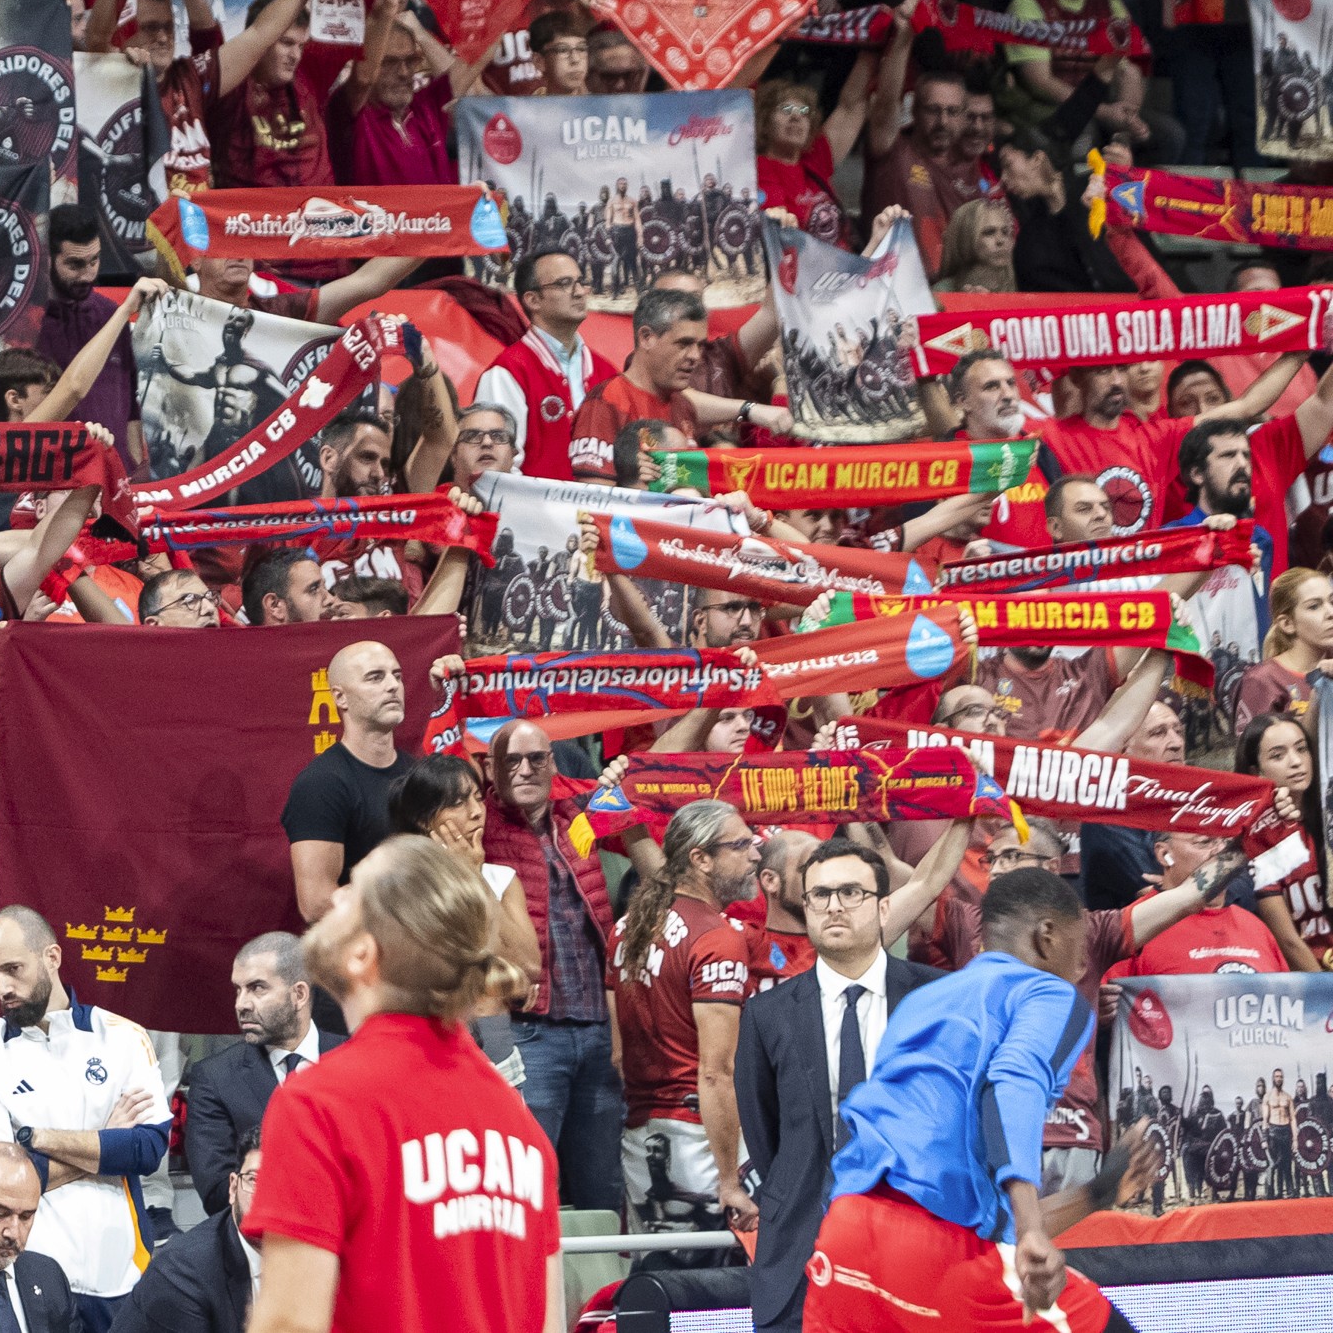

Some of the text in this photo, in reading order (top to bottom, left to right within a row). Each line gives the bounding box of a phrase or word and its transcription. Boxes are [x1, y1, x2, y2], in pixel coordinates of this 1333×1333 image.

[563, 115, 648, 146] UCAM
[989, 302, 1243, 362] COMO UNA SOLA ALMA
[765, 457, 959, 492] UCAM MURCIA CB
[1007, 744, 1131, 812] MURCIA
[1214, 993, 1305, 1031] UCAM
[401, 1127, 545, 1212] UCAM
[434, 1194, 528, 1242] MURCIA
